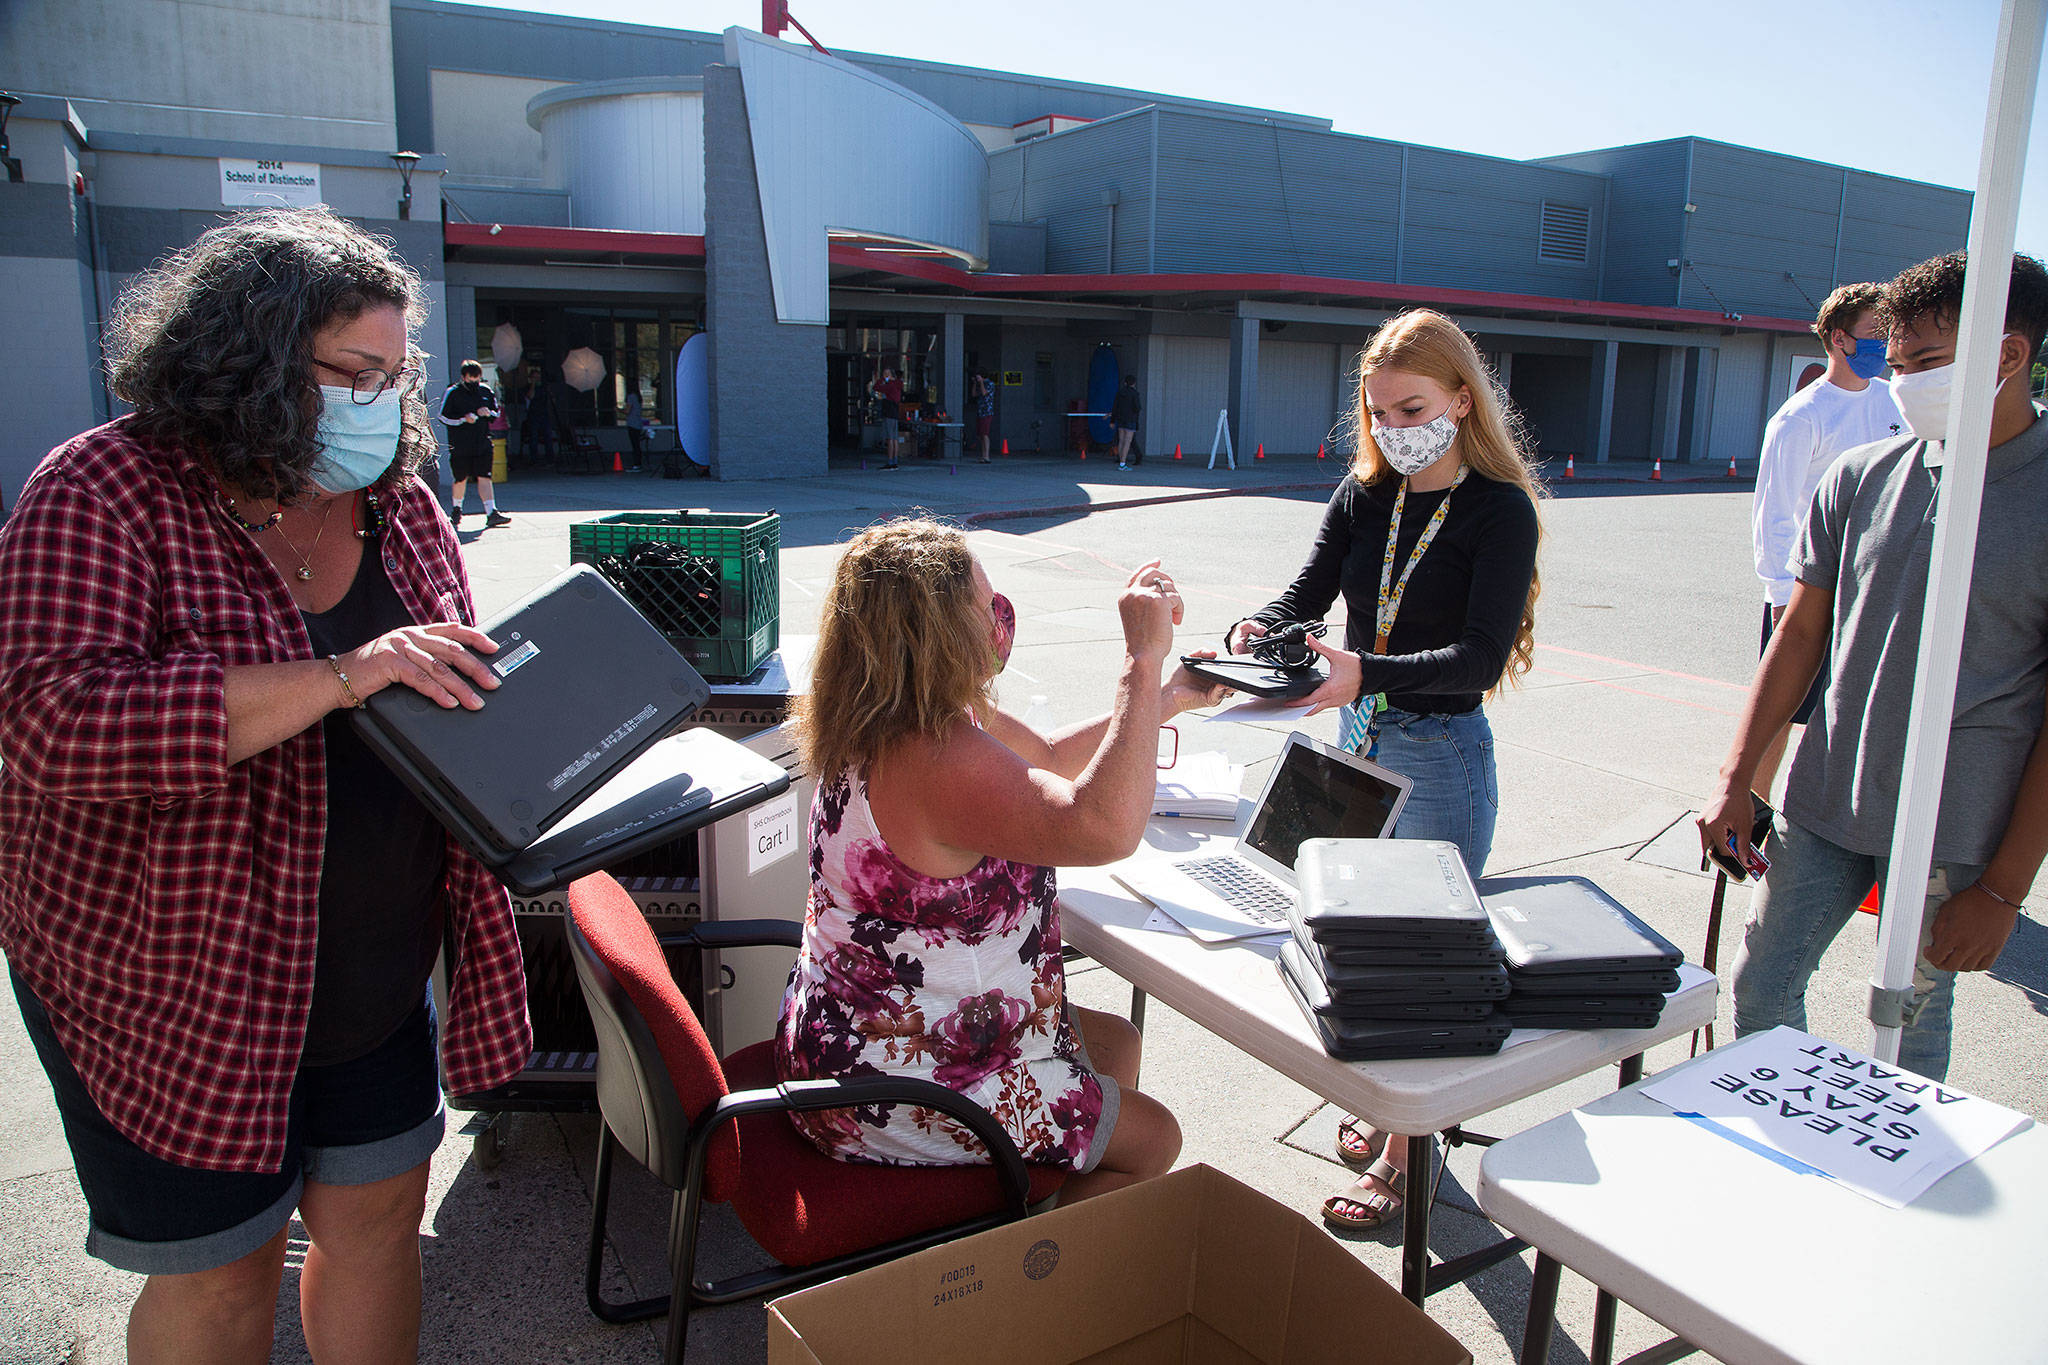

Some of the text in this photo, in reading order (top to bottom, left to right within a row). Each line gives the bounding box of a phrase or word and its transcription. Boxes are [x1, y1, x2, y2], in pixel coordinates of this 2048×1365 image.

[225, 170, 315, 186] School of Distinction
[257, 160, 283, 169] 2014
[758, 828, 782, 854] Cart
[1798, 1045, 1969, 1105] APART
[1750, 1067, 1920, 1140] STAY 6
[1793, 1064, 1921, 1116] FEET
[1710, 1073, 1909, 1162] PLEASE
[941, 1264, 976, 1285] #00019
[933, 1279, 984, 1307] 24X18X18
